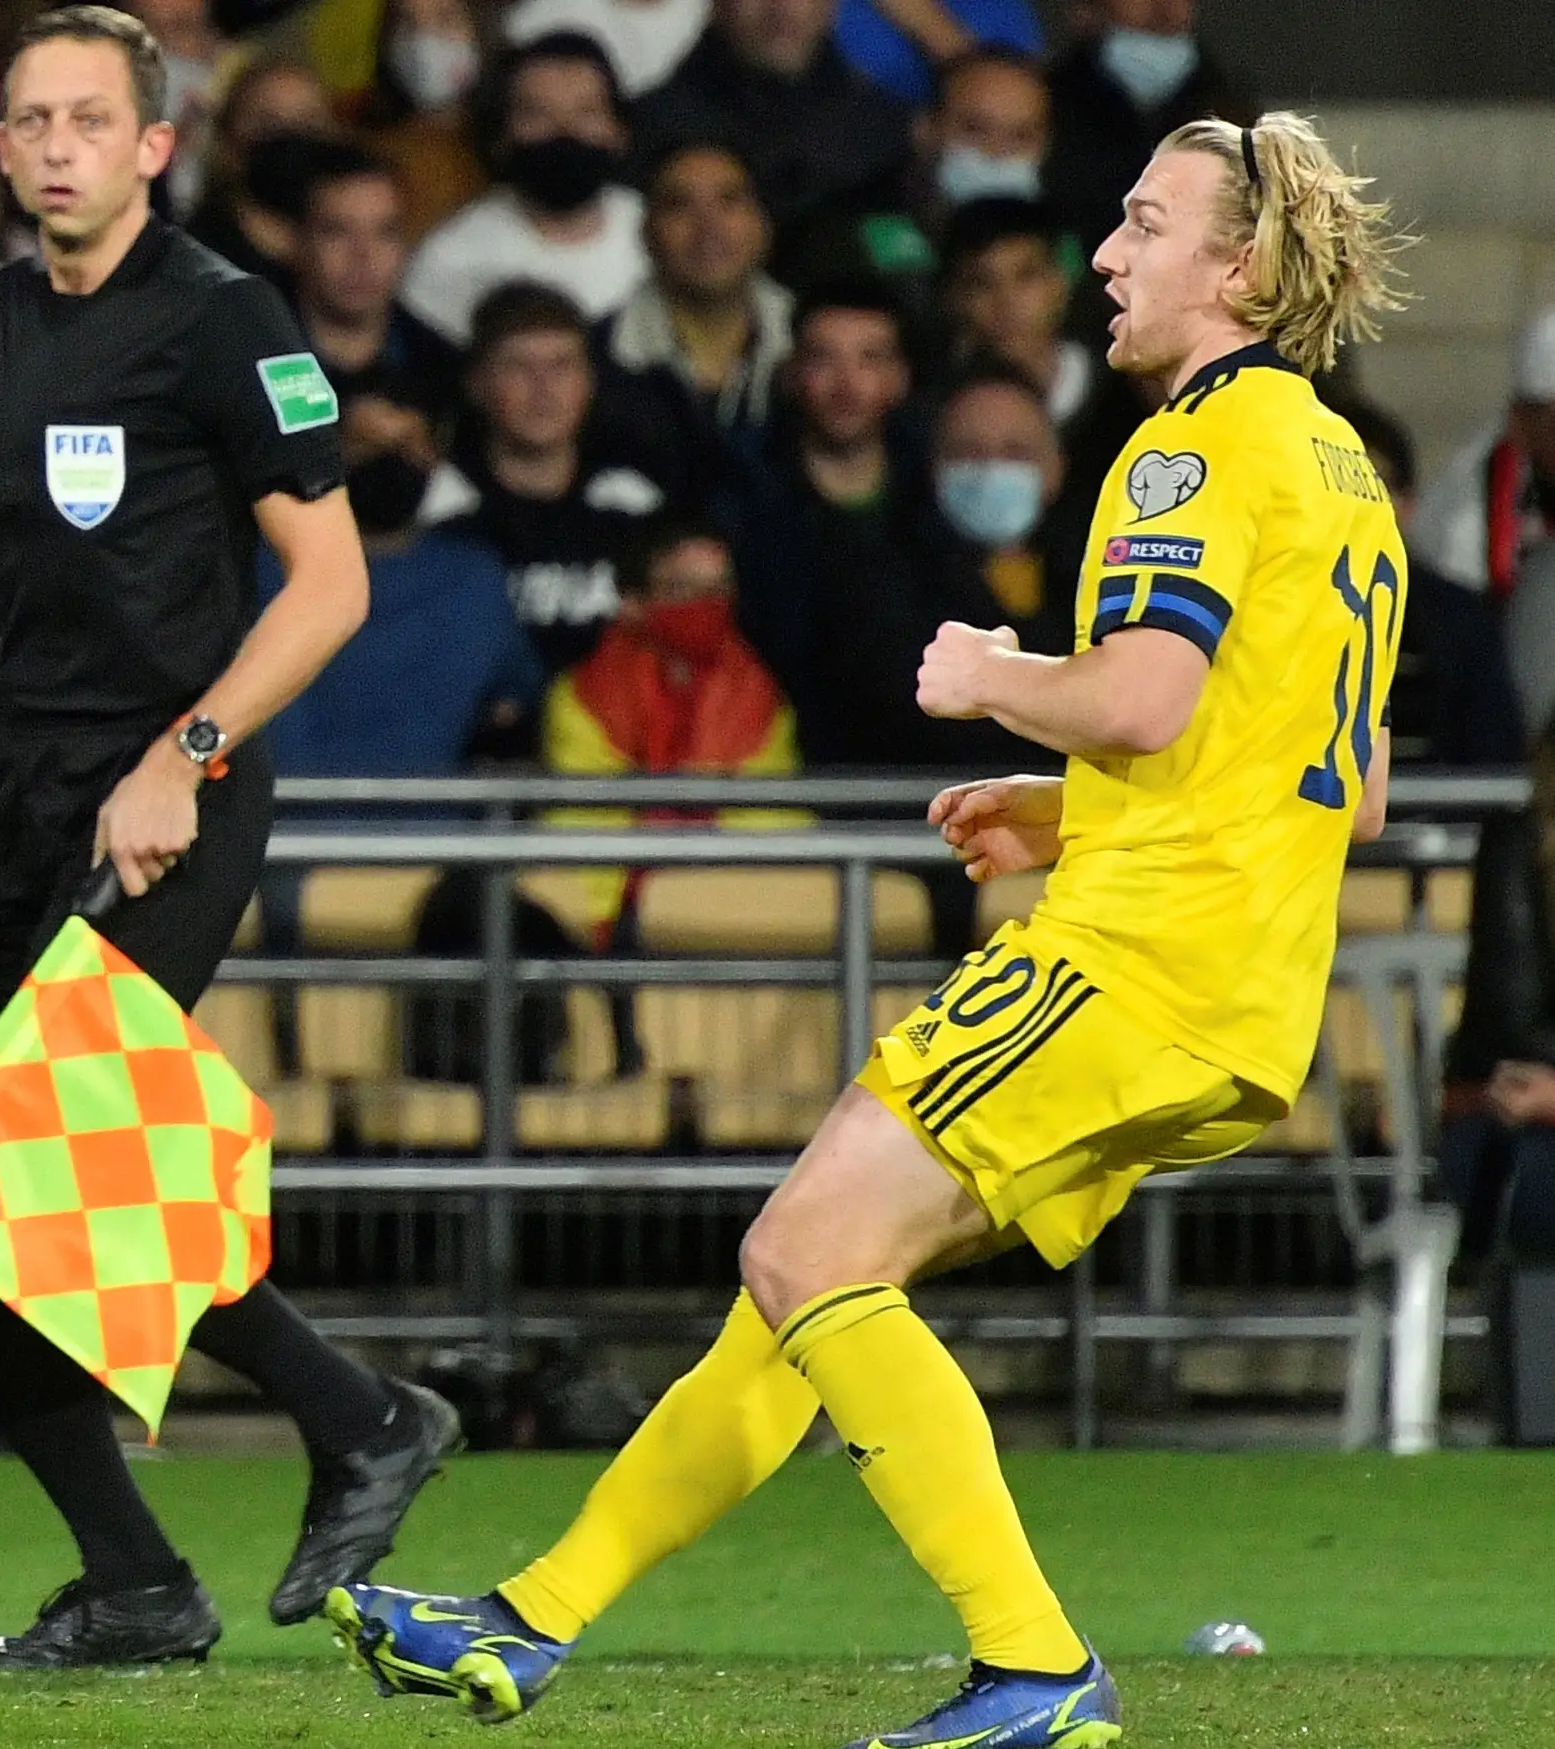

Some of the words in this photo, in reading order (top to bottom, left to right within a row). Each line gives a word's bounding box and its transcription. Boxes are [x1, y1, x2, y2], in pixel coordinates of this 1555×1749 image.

[55, 433, 114, 455] FIFA
[1129, 543, 1202, 562] RESPECT
[1297, 543, 1399, 810] 10
[924, 942, 1037, 1028] 10
